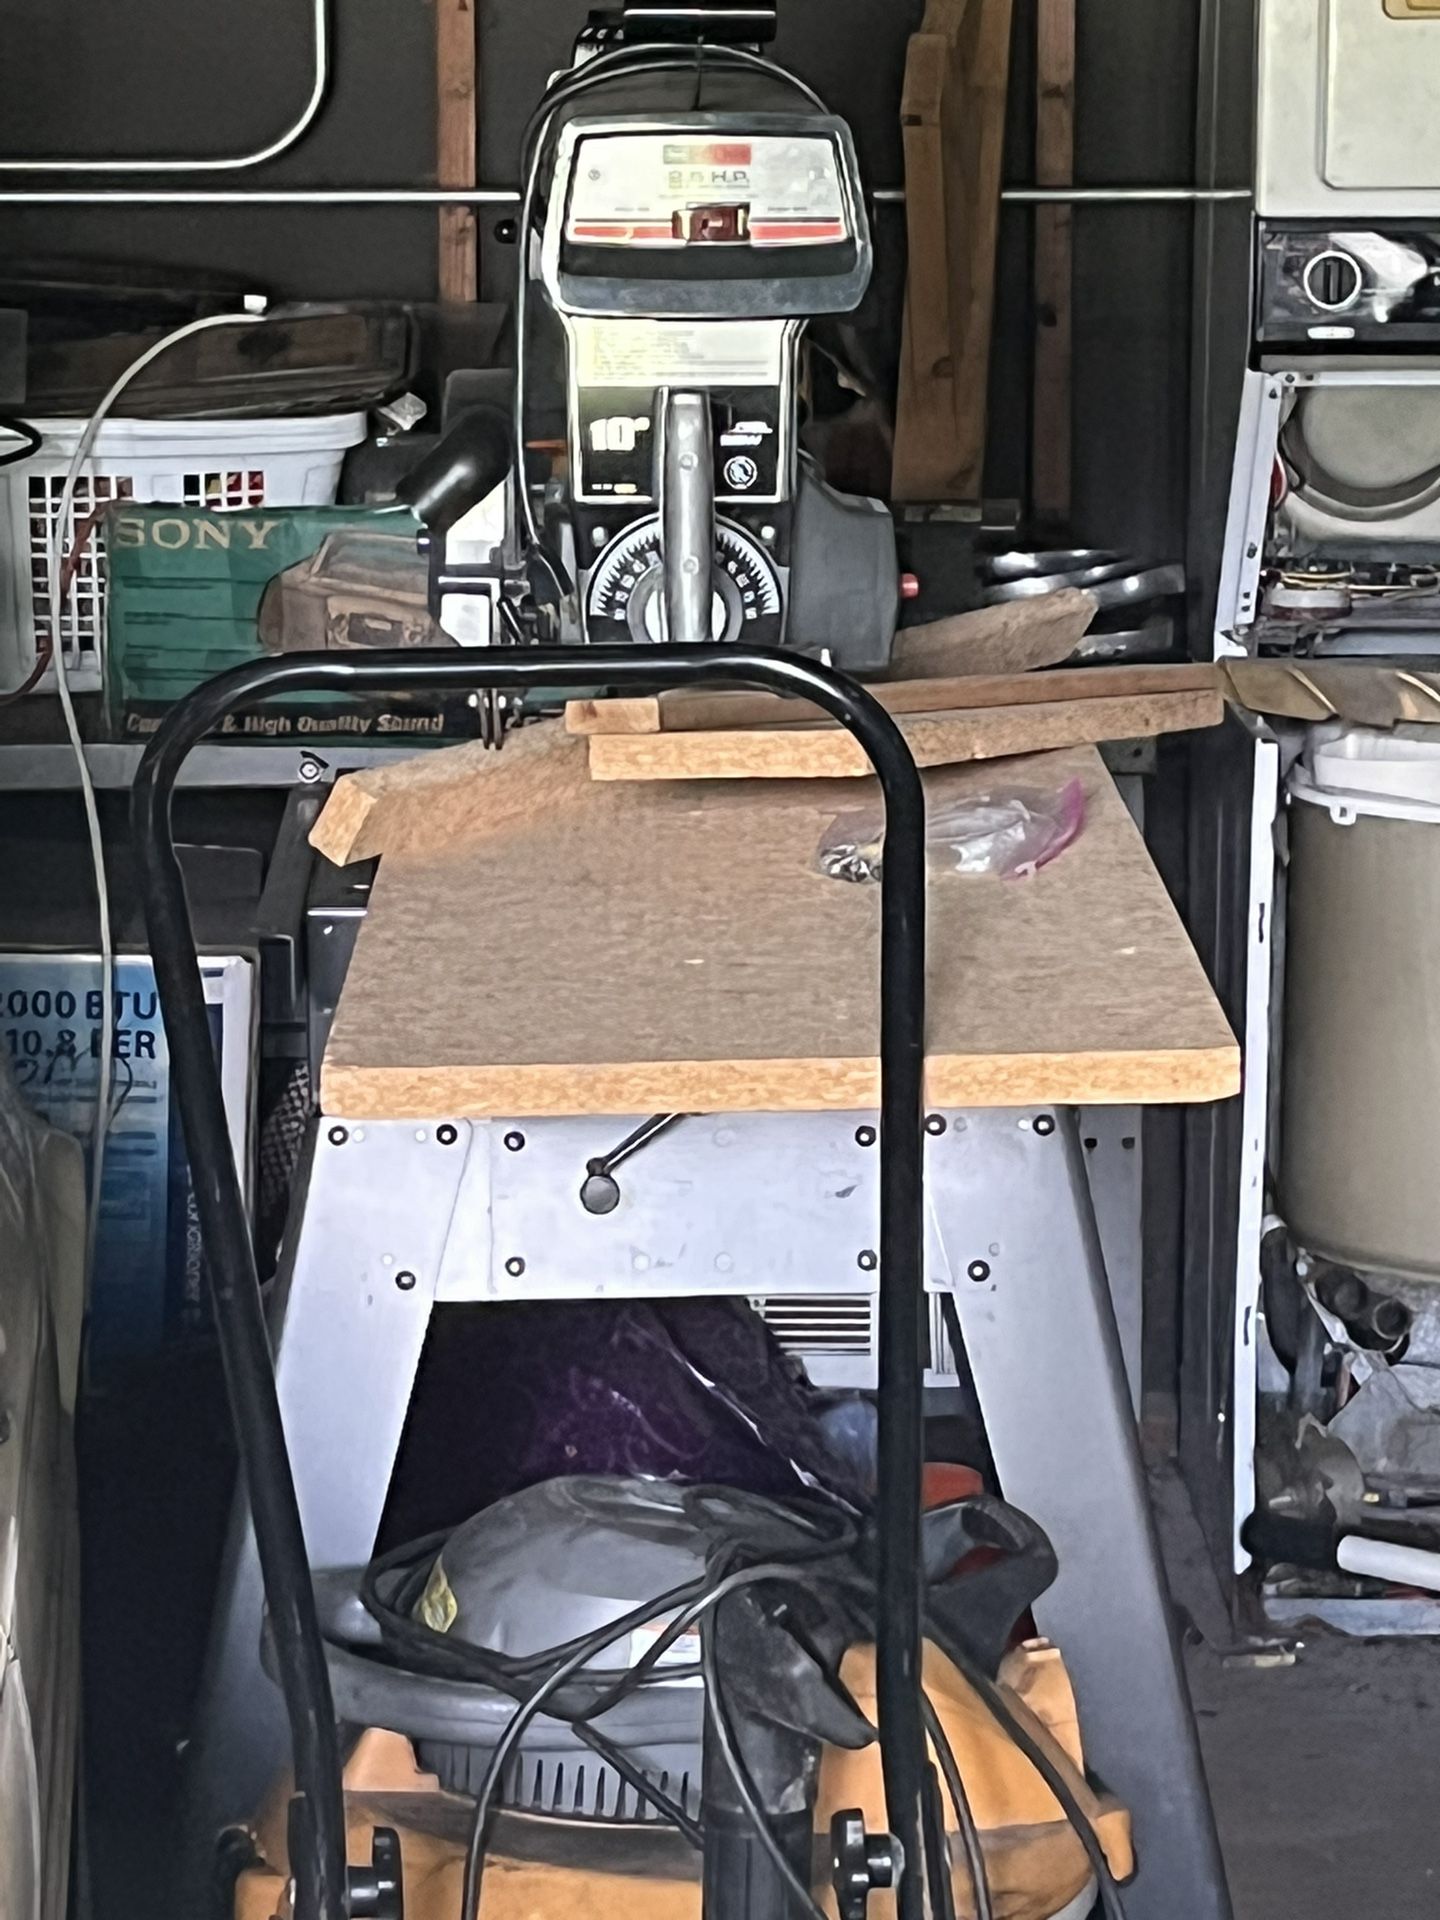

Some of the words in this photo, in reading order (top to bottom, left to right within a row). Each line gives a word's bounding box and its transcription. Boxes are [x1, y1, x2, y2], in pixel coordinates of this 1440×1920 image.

[114, 518, 279, 549] SONY
[244, 715, 292, 735] High
[297, 715, 372, 733] Quality
[377, 713, 445, 734] Sound
[0, 990, 77, 1018] 000
[86, 990, 157, 1019] BTU
